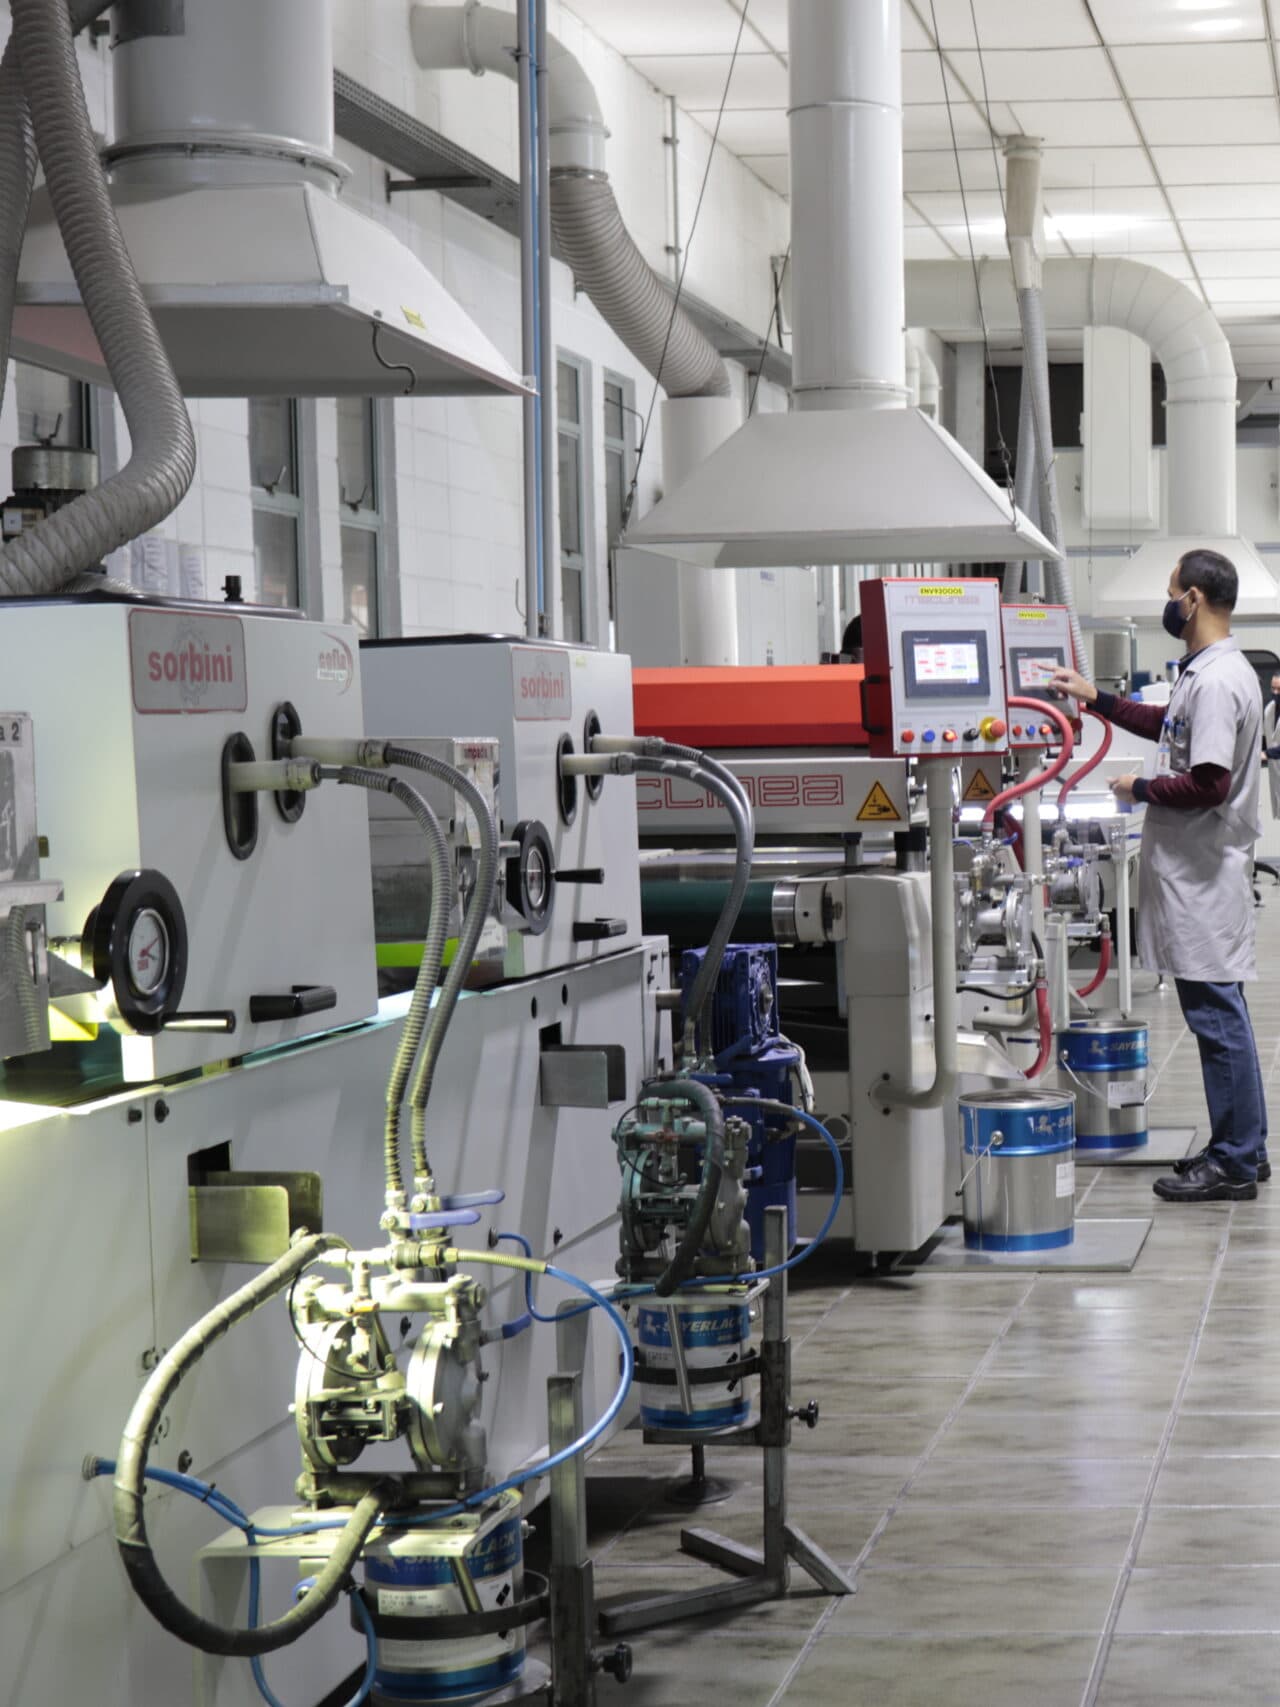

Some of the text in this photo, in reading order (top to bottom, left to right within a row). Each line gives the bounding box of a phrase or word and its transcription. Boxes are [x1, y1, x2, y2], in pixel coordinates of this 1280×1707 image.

[147, 641, 234, 684] sorbini
[520, 671, 565, 699] sorbini
[11, 721, 20, 741] 2
